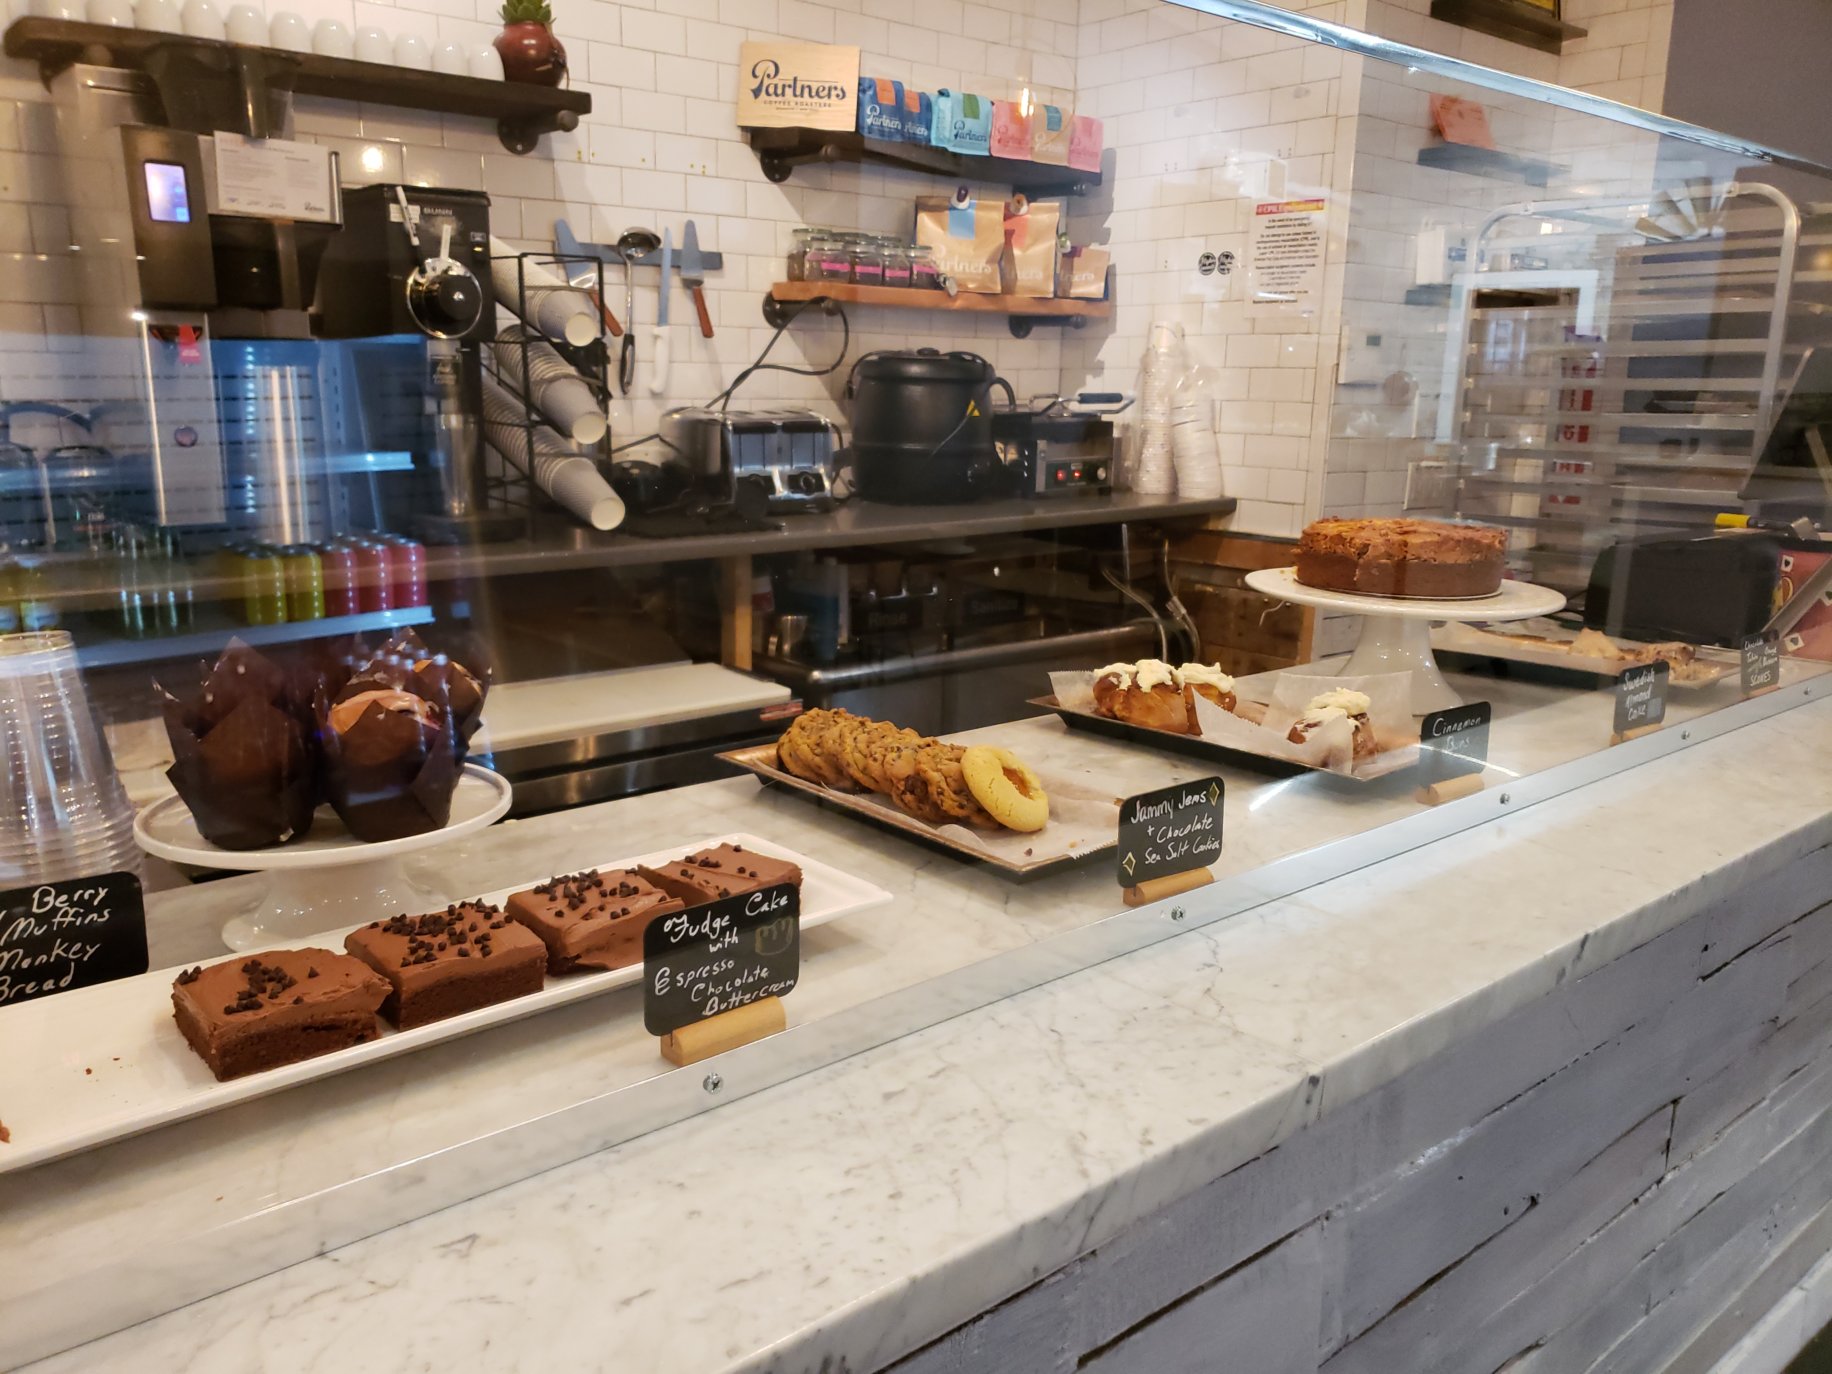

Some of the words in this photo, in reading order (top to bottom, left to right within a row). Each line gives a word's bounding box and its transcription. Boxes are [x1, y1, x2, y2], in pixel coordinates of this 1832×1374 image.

[750, 59, 847, 100] Partners
[1131, 799, 1174, 824] Jammy
[1157, 812, 1213, 844] Chocolate
[1145, 847, 1161, 865] Sea
[1166, 840, 1190, 861] Salt
[32, 886, 109, 914] Berry
[664, 910, 731, 944] Fudge
[745, 891, 788, 916] Cake
[0, 907, 112, 946] Muffins
[709, 927, 739, 953] with
[654, 958, 735, 996] Espresso
[691, 965, 770, 1003] Chocolate
